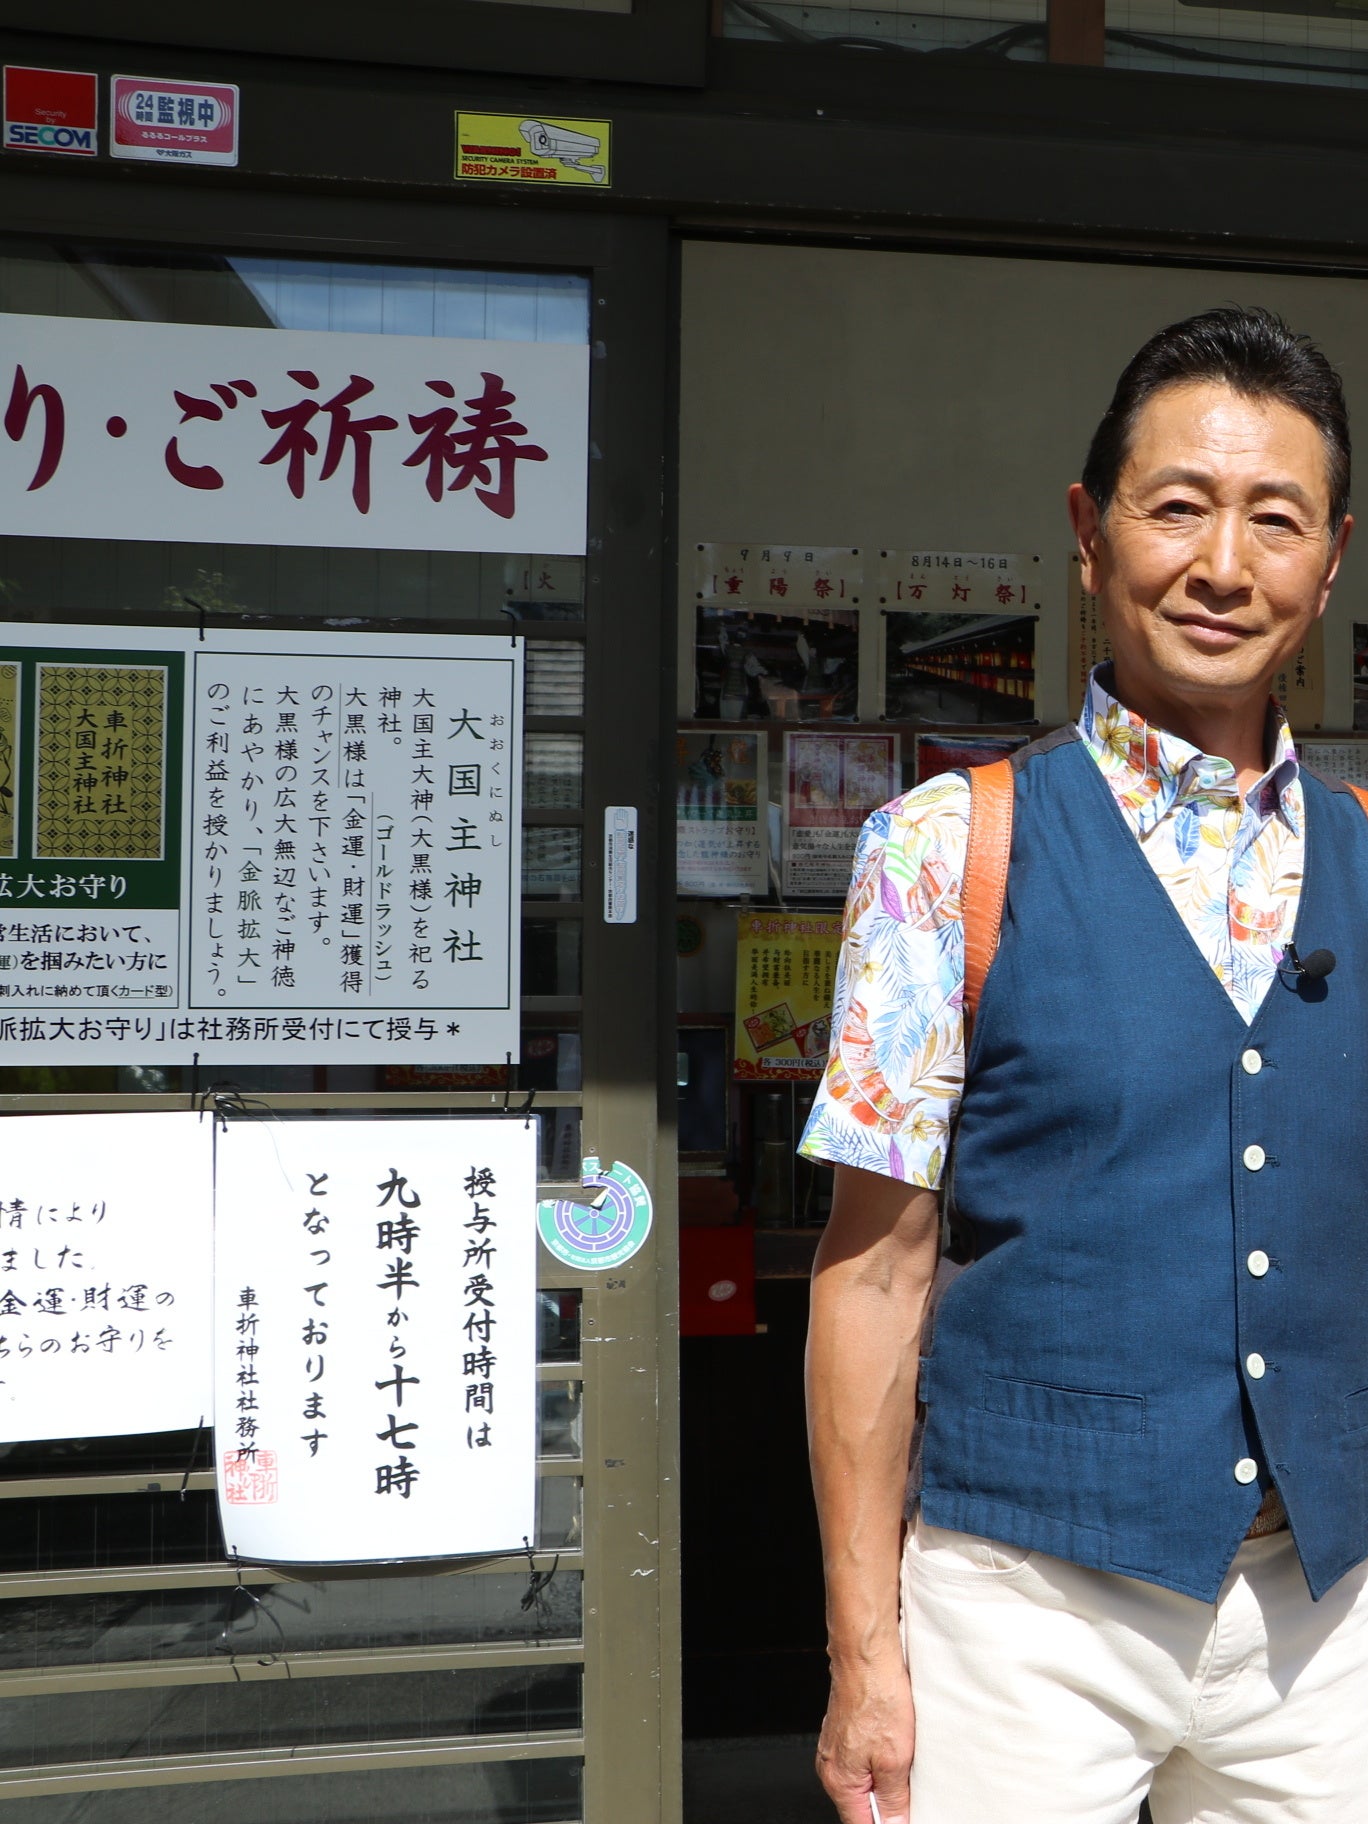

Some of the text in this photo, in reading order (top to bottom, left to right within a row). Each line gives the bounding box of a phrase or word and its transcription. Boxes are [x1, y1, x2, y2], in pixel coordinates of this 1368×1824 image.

[9, 125, 91, 149] SECOM
[35, 108, 67, 119] Security
[45, 117, 56, 125] by
[136, 93, 153, 110] 24
[136, 111, 153, 122] 時間
[158, 96, 214, 128] 監視中
[490, 156, 514, 164] CAMERA
[462, 163, 557, 179] 防犯カメラ設置済
[4, 363, 548, 519] り・ご祈祷
[72, 708, 99, 814] 大国主神社
[101, 710, 129, 815] 車折神社
[377, 686, 402, 745] 神社。
[489, 713, 505, 847] おおくにぬし
[203, 683, 230, 996] のご利益を授かりましょう。
[238, 686, 264, 984] にあやかり、「金脈拡大」
[272, 685, 299, 988] 大黒様の広大無辺なご神徳
[308, 684, 333, 945] のチャンスを下さいます。
[340, 686, 368, 993] 大黒様は「金運・財運」獲得
[408, 687, 436, 990] 大国主大神（大黒様）を祀る
[443, 708, 485, 963] 大国主神社
[0, 923, 151, 944] 生活において、
[374, 814, 394, 981] （ゴールドラッシュ）
[0, 1283, 175, 1315] 金運・財運の
[302, 1172, 331, 1458] となっております
[374, 1169, 420, 1500] 九時半から十七時
[462, 1166, 497, 1448] 授与所受付時間は
[235, 1286, 260, 1463] 車折神社社務所
